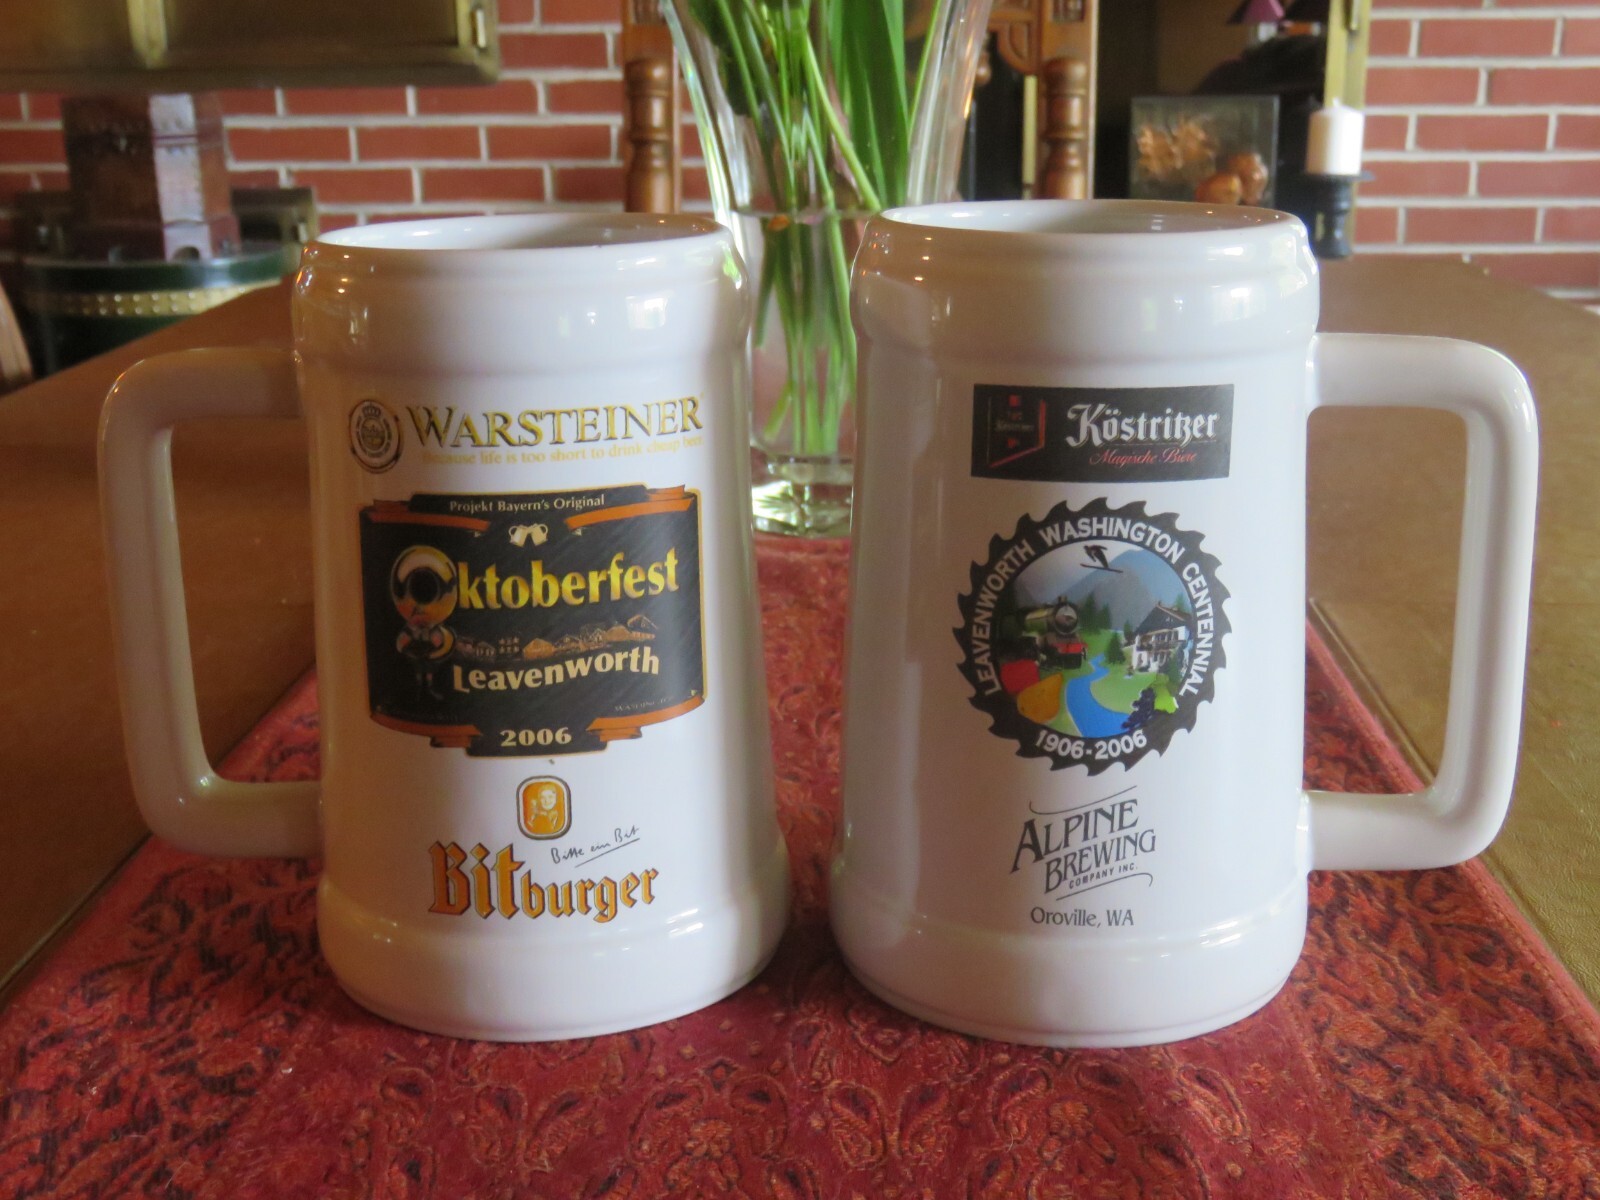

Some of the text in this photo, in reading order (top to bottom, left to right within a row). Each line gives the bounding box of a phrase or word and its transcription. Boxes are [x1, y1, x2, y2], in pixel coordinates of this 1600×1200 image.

[405, 396, 703, 448] WARSTEINER
[480, 449, 503, 464] life
[506, 449, 518, 464] is
[521, 449, 546, 463] too
[550, 446, 586, 462] short
[591, 446, 605, 458] to
[608, 442, 642, 457] drink
[646, 439, 680, 453] cheap
[449, 494, 606, 514] Projekt Bayern's Original
[972, 516, 1215, 697] LEAVENWORTH WASHINGTON CENTENNIAL
[453, 646, 660, 693] Leavenworth
[500, 727, 572, 748] 2006
[1035, 729, 1147, 760] 1906-2006
[550, 847, 585, 865] Bitte
[614, 825, 639, 844] Bit
[1010, 798, 1139, 874] ALPINE
[1044, 828, 1156, 894] BREWING
[1069, 862, 1138, 889] COMPANY INC.
[428, 841, 659, 923] Bitburger
[1030, 906, 1135, 928] Oroville, WA
